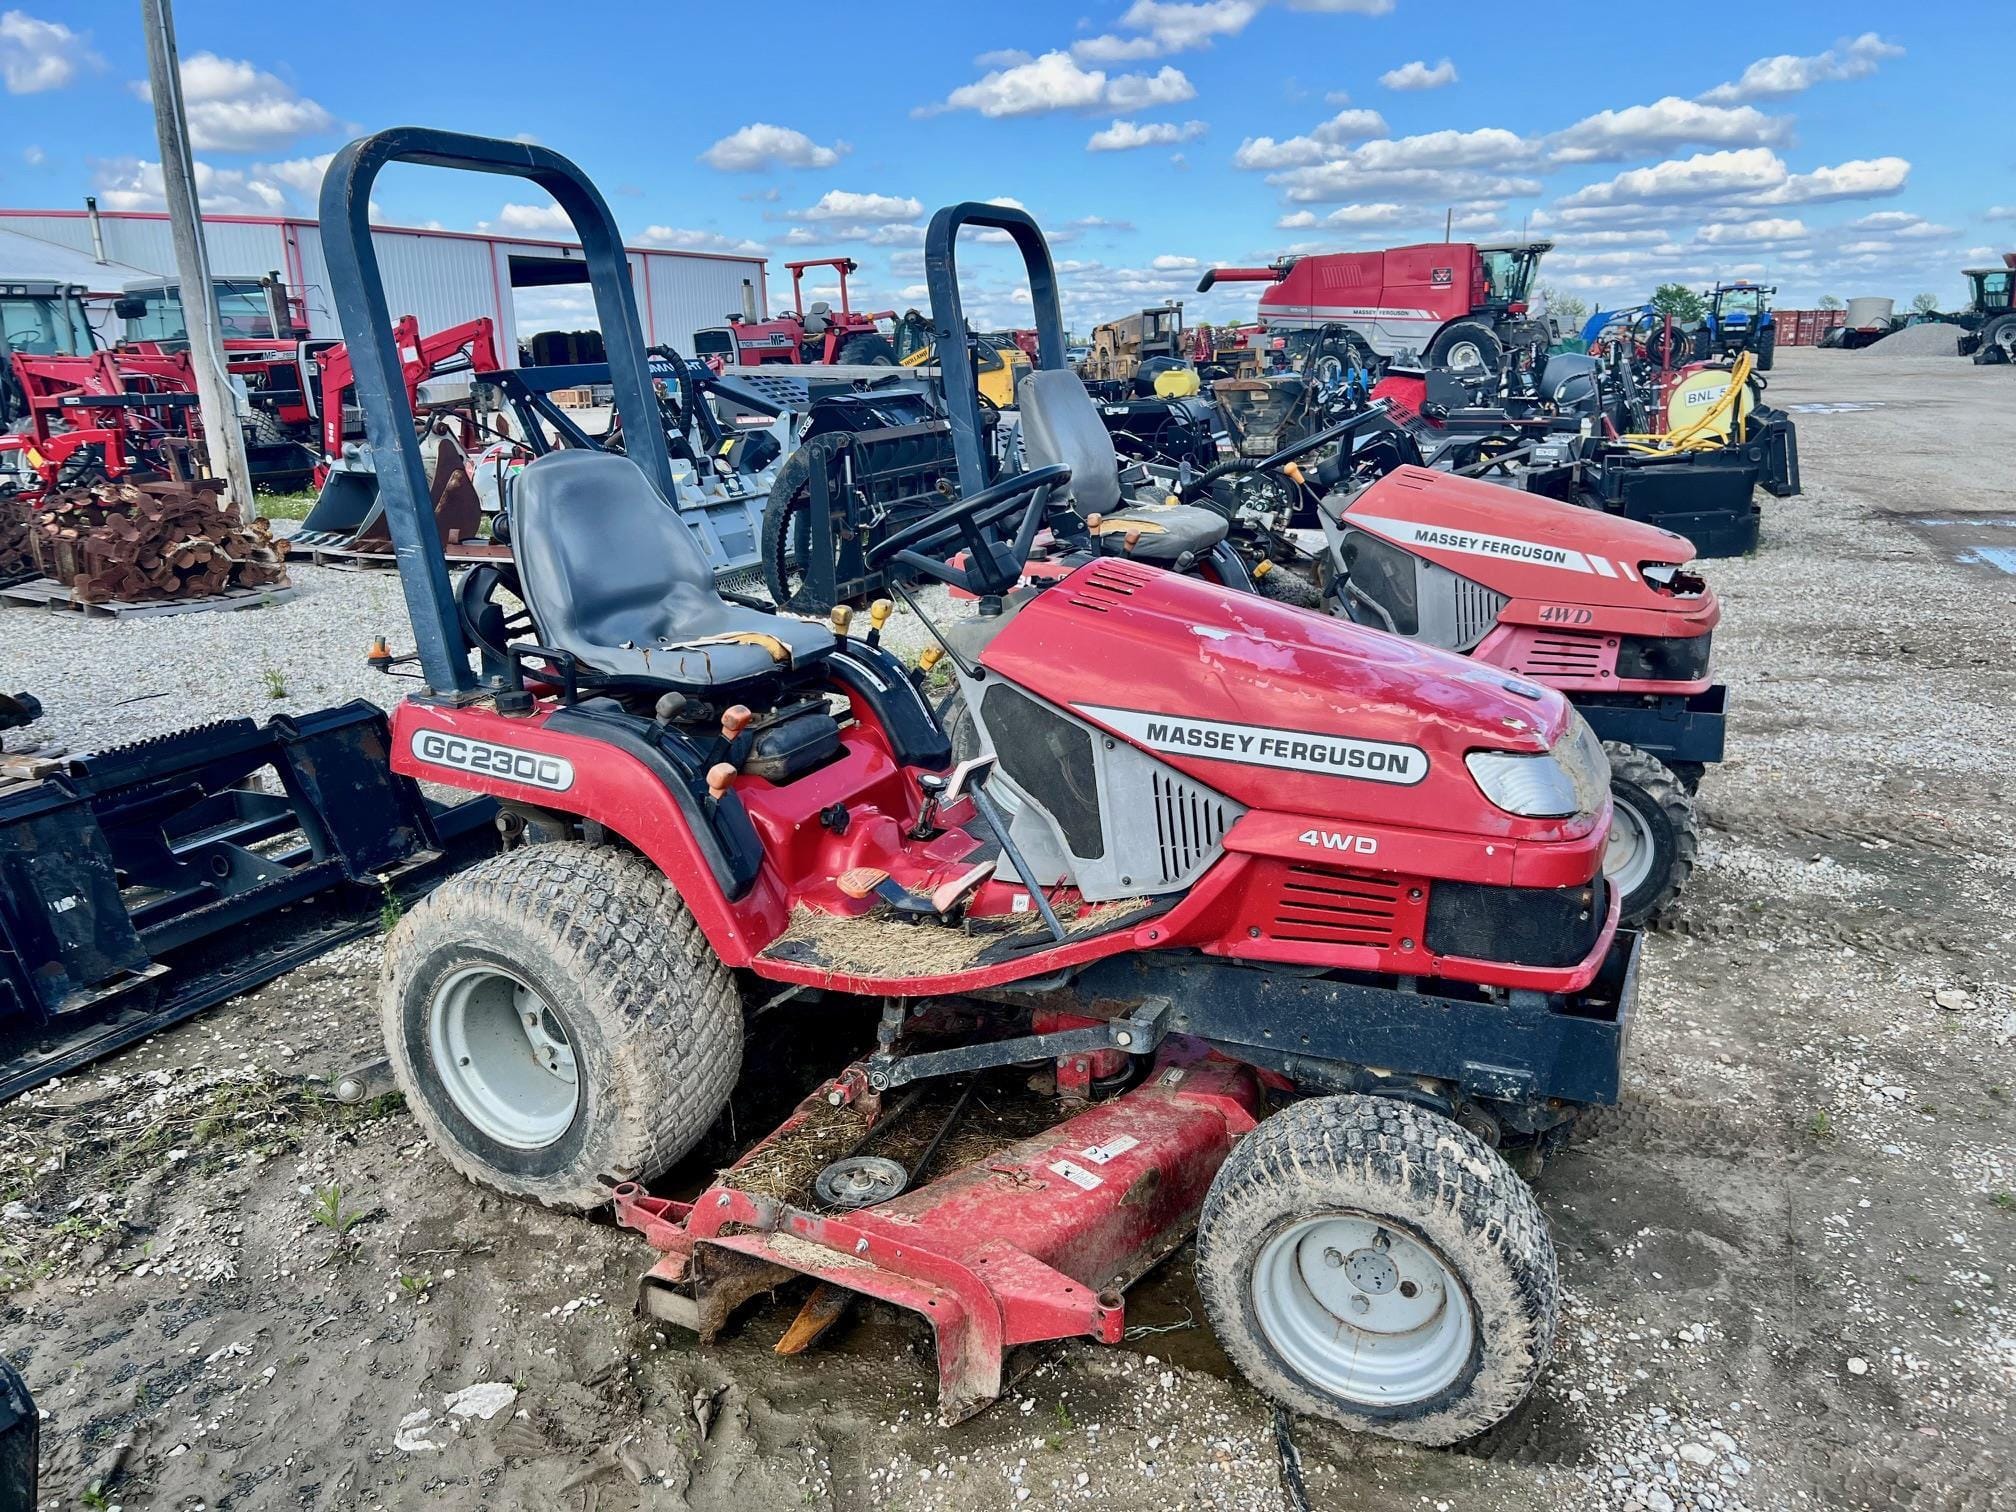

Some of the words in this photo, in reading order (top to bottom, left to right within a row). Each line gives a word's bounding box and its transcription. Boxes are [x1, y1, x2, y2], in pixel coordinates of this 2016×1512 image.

[771, 335, 784, 345] MF
[1688, 390, 1714, 403] BNL
[799, 415, 814, 437] EDGE
[1414, 530, 1478, 549] MASSEY
[1481, 540, 1566, 563] FERGUSON
[1540, 606, 1592, 624] 4WD
[423, 735, 560, 785] GC2300
[1146, 723, 1254, 754] MASSEY
[1259, 738, 1409, 774] FERGUSON
[1298, 829, 1377, 854] 4WD
